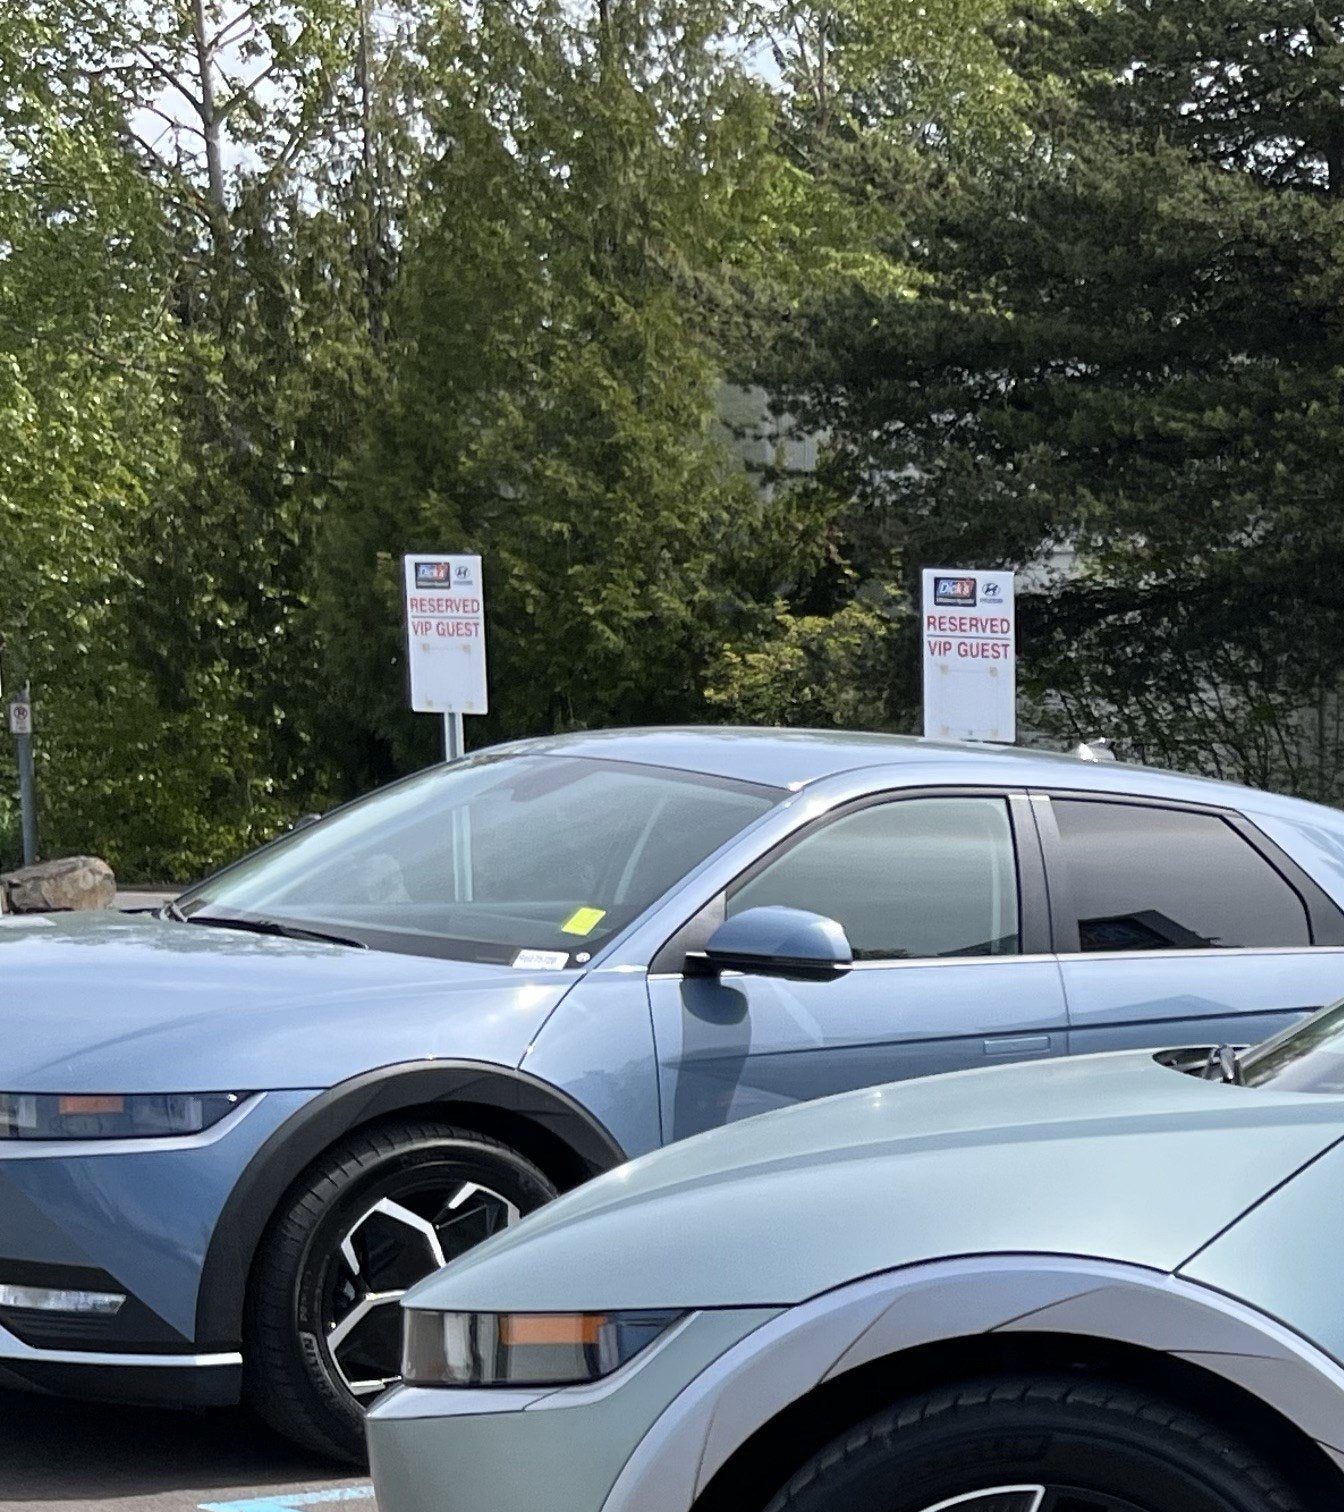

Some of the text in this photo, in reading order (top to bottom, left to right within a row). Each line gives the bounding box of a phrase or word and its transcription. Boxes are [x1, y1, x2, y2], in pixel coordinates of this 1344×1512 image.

[409, 597, 481, 614] RESERVED
[411, 620, 480, 638] VIP GUEST
[926, 615, 1011, 635] RESERVED
[927, 640, 1010, 660] VIP GUEST
